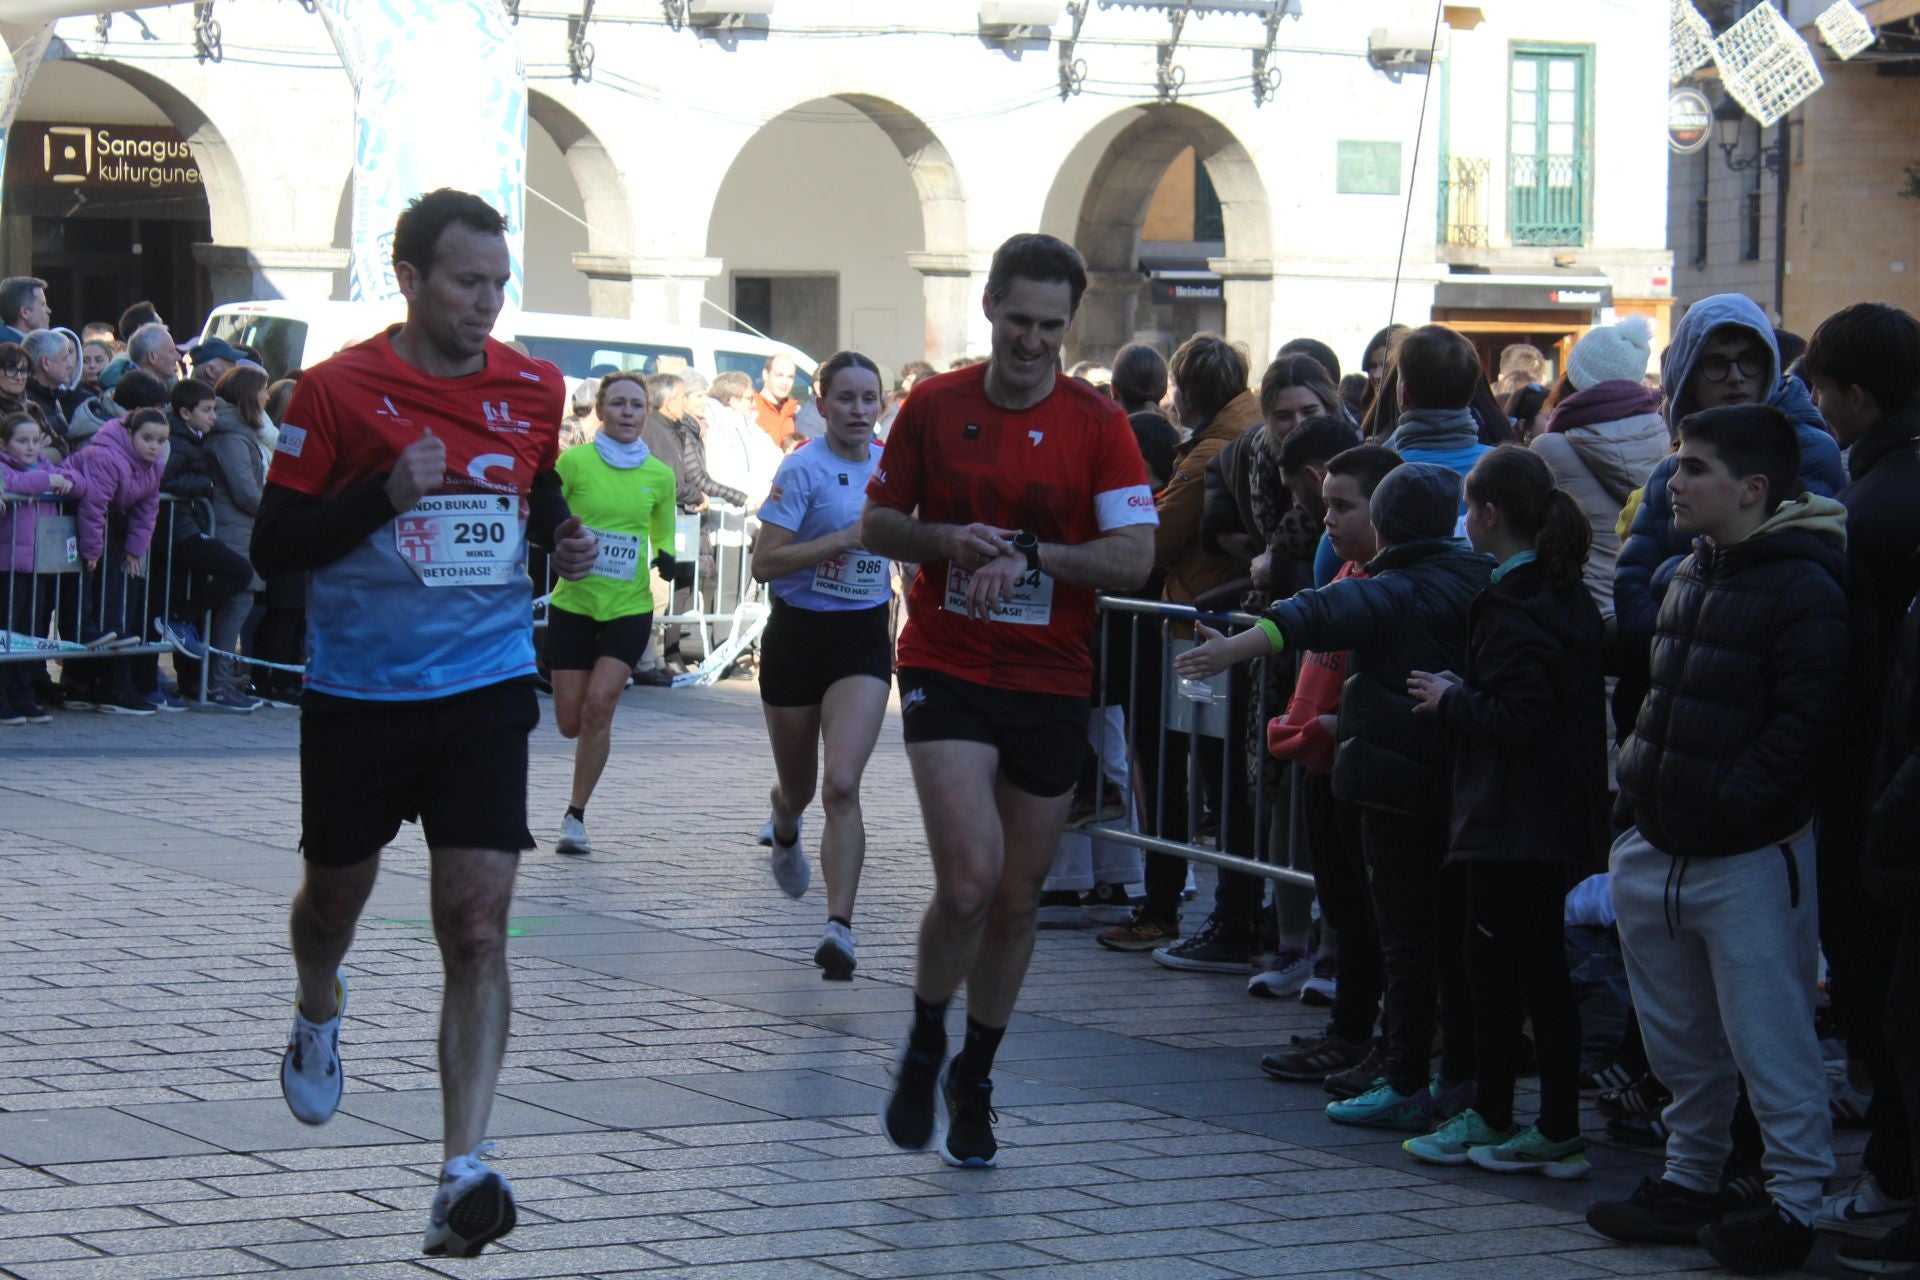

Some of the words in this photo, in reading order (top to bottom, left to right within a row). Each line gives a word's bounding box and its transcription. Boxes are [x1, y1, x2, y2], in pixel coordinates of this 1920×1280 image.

[99, 156, 203, 188] kulturgune
[1175, 285, 1220, 297] Heineken
[411, 501, 442, 512] NDO
[445, 500, 487, 510] BUKAU
[453, 522, 505, 544] 290
[603, 545, 636, 560] 1070
[423, 567, 457, 578] BETO
[459, 566, 491, 576] HASI!
[856, 559, 882, 574] 986
[816, 580, 851, 593] HOBETO
[1001, 607, 1022, 617] ASI!
